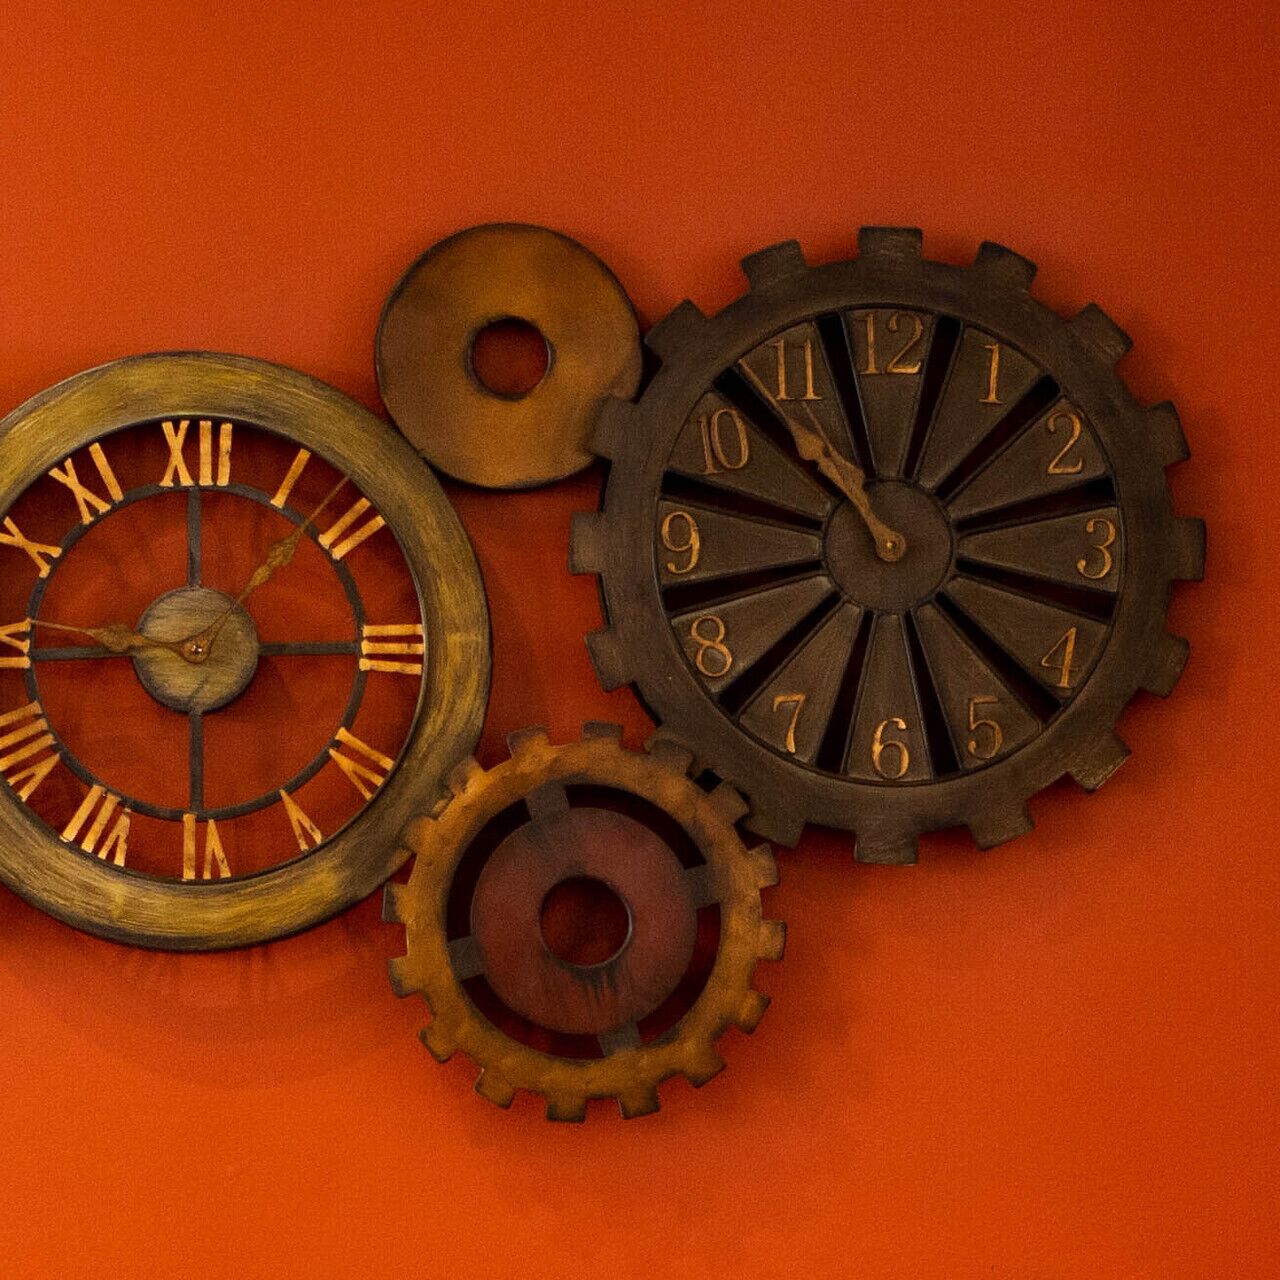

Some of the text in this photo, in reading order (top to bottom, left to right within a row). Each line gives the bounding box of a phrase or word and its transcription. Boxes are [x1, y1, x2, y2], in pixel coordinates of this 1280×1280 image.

[771, 339, 822, 402] 11
[857, 312, 925, 376] 12
[980, 343, 1004, 405] 1
[159, 420, 233, 486] XII
[695, 407, 750, 476] 10
[1046, 412, 1084, 475] 2
[48, 442, 124, 525] XI
[318, 497, 386, 560] II
[661, 510, 701, 575] 9
[1076, 518, 1117, 580] 3
[358, 623, 424, 675] III
[690, 615, 733, 678] 8
[1041, 626, 1077, 688] 4
[772, 693, 806, 754] 7
[872, 717, 911, 780] 6
[967, 697, 1004, 759] 5
